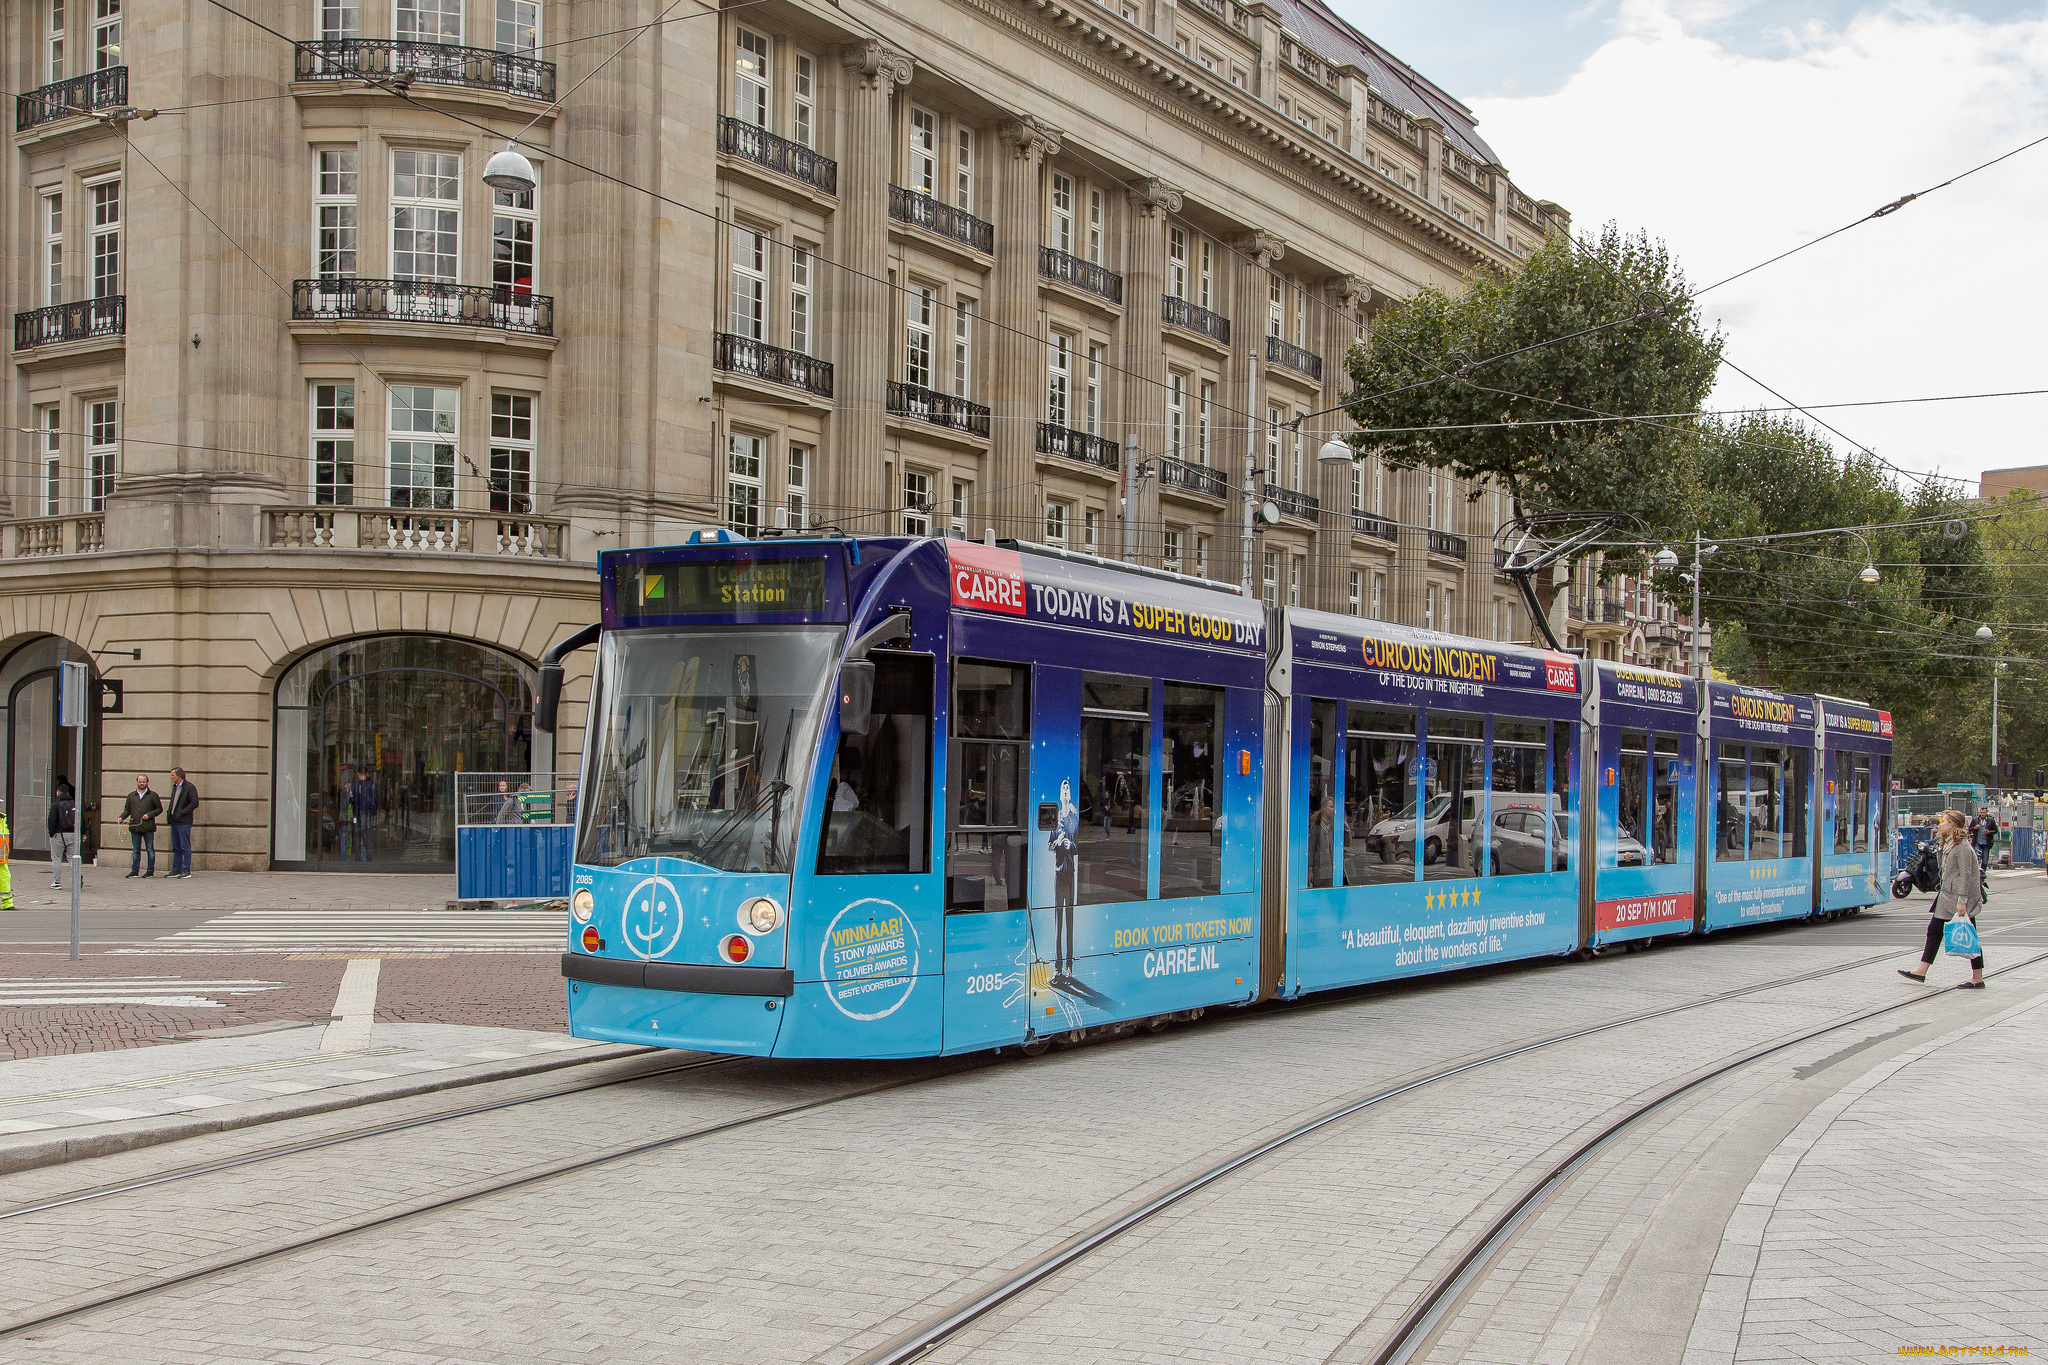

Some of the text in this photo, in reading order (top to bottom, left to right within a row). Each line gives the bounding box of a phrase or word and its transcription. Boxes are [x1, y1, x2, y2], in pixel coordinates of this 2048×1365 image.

[635, 568, 645, 607] 1
[721, 584, 785, 604] Station
[1031, 584, 1261, 646] TODAY IS A SUPER GOOD DAY
[1362, 635, 1497, 682] CURIOUS INCIDENT
[1380, 672, 1485, 697] OF THE DOG IN THE NIGHT-TIME
[1657, 673, 1682, 688] TICKETS
[1648, 687, 1660, 701] 0900
[1731, 695, 1795, 723] CURIOUS INCIDENT
[1825, 713, 1839, 727] TODAY
[1844, 716, 1848, 729] A
[1847, 717, 1860, 730] SUPER
[1860, 719, 1872, 732] GOOD
[575, 874, 593, 885] 2085
[1728, 890, 1733, 903] of
[1733, 889, 1741, 902] the
[1741, 888, 1753, 901] most
[1616, 899, 1677, 922] 20 SEP T/M 1 OKT
[831, 917, 904, 947] WINNAAR!
[1114, 917, 1252, 948] BOOK YOUR TICKETS NOW
[1357, 925, 1402, 948] beautiful,
[1404, 920, 1446, 944] eloquent,
[1448, 914, 1488, 937] dazzlingly
[1490, 911, 1524, 931] inventive
[1525, 910, 1546, 926] show
[834, 937, 905, 963] 5 TONY AWARDS
[1143, 945, 1219, 979] CARRE.NL
[1395, 947, 1423, 966] about
[1424, 944, 1439, 962] the
[1441, 939, 1477, 959] wonders
[1479, 937, 1488, 954] of
[837, 955, 908, 980] 7 OLIVIER AWARDS
[838, 976, 910, 1000] BESTE VOORSTELLING
[966, 972, 1003, 994] 2085
